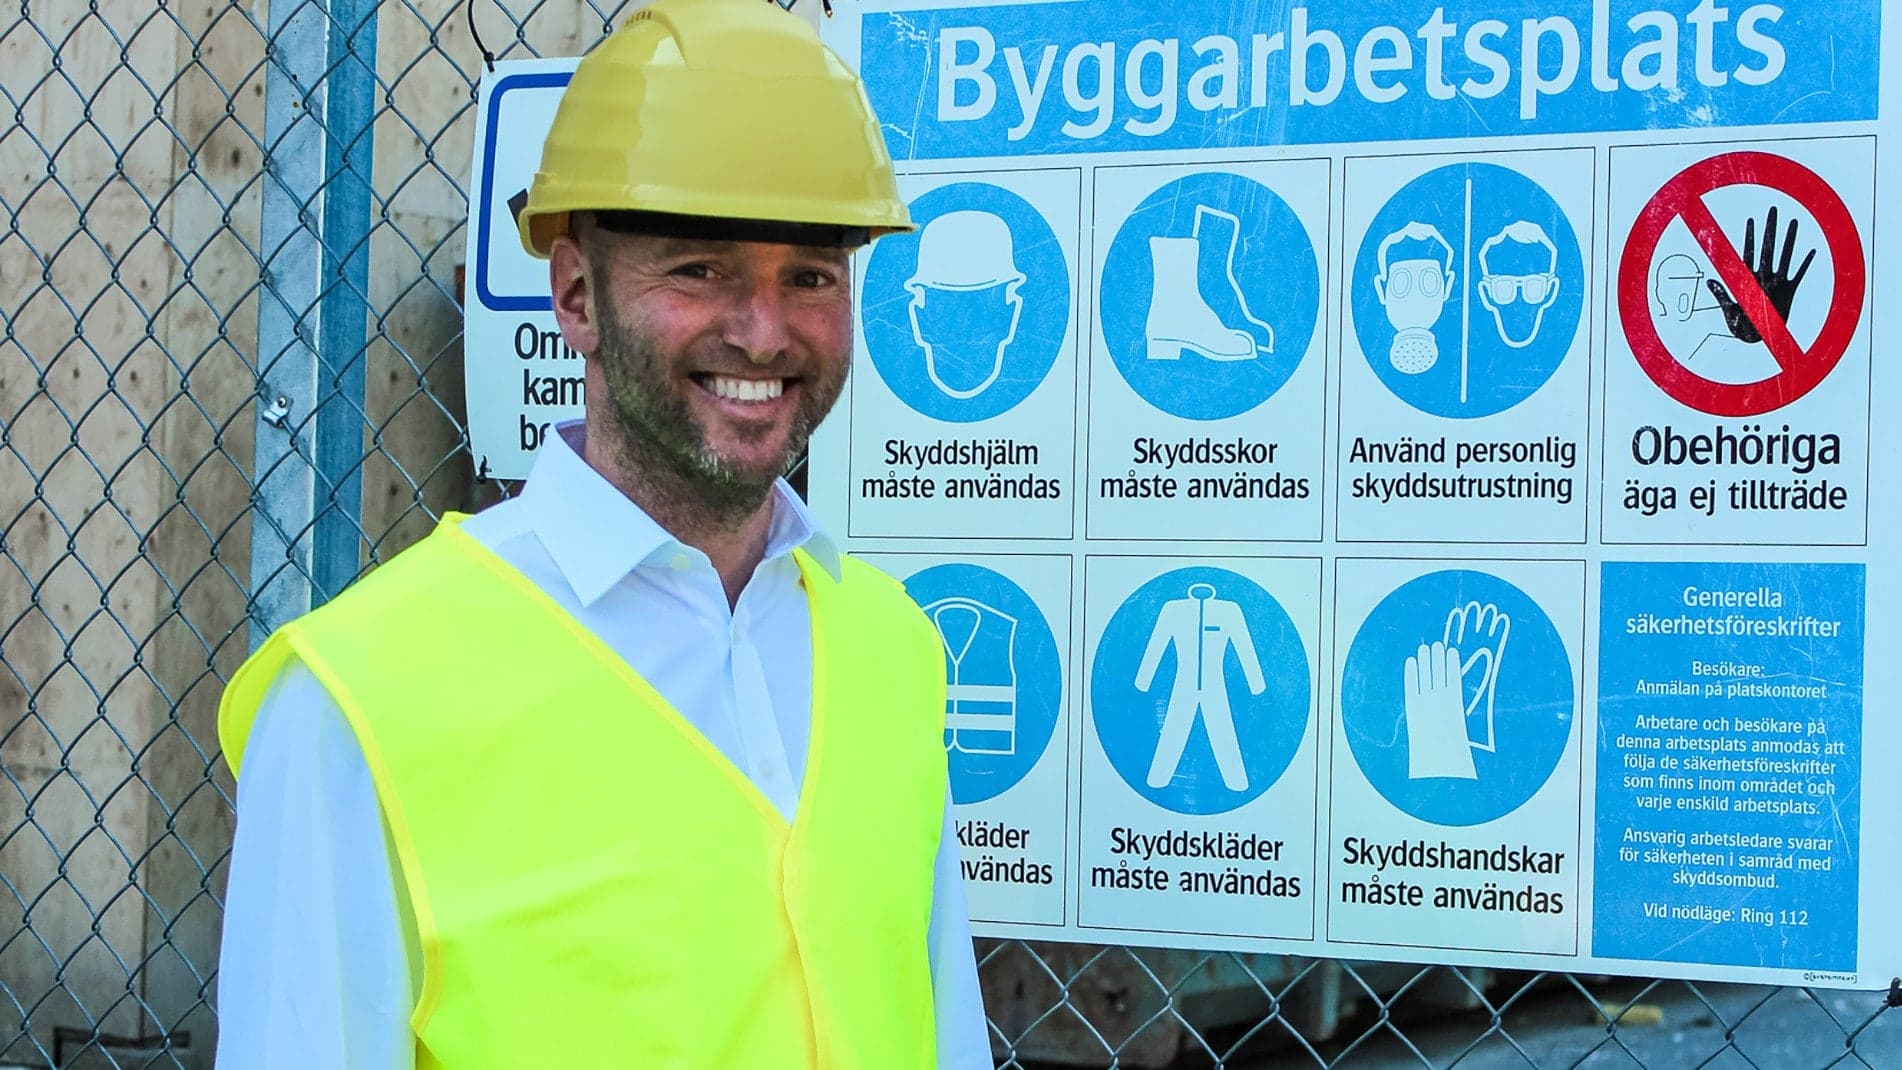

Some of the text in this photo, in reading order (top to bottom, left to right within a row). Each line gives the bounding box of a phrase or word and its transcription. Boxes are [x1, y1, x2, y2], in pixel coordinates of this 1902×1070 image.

[935, 0, 1787, 142] Byggarbetsplats
[885, 439, 1037, 470] Skyddshjälm
[1134, 438, 1277, 469] Skyddsskor
[1350, 436, 1575, 468] Använd personlig
[1632, 425, 1840, 472] Obehöriga
[863, 471, 1060, 498] måste användas
[1101, 470, 1309, 498] måste användas
[1352, 472, 1572, 504] skyddsutrustning
[1624, 480, 1847, 516] äga ej tillträde
[1684, 587, 1782, 607] Generella
[1627, 614, 1840, 636] säkerhetsföreskrifter
[1693, 661, 1765, 677] Besökare:
[1636, 680, 1827, 699] Anmälan på platskontoret
[1636, 715, 1826, 736] Arbetare och besökare på
[1617, 734, 1845, 755] denna arbetsplats anmodas att
[1624, 754, 1836, 774] följa de säkerhetsföreskrifter
[1624, 775, 1835, 797] som finns inom området och
[1637, 795, 1819, 816] varje enskild arbetsplats.
[1111, 828, 1283, 867] Skyddskläder
[1623, 828, 1832, 850] Ansvarig arbetsledare svarar
[1343, 837, 1564, 874] Skyddshandskar
[1619, 847, 1830, 870] för säkerheten i samråd med
[1092, 860, 1300, 897] måste användas
[1673, 870, 1778, 888] skyddsombud.
[1342, 875, 1563, 913] måste användas
[1644, 903, 1808, 926] Vid nödläge: Ring 112
